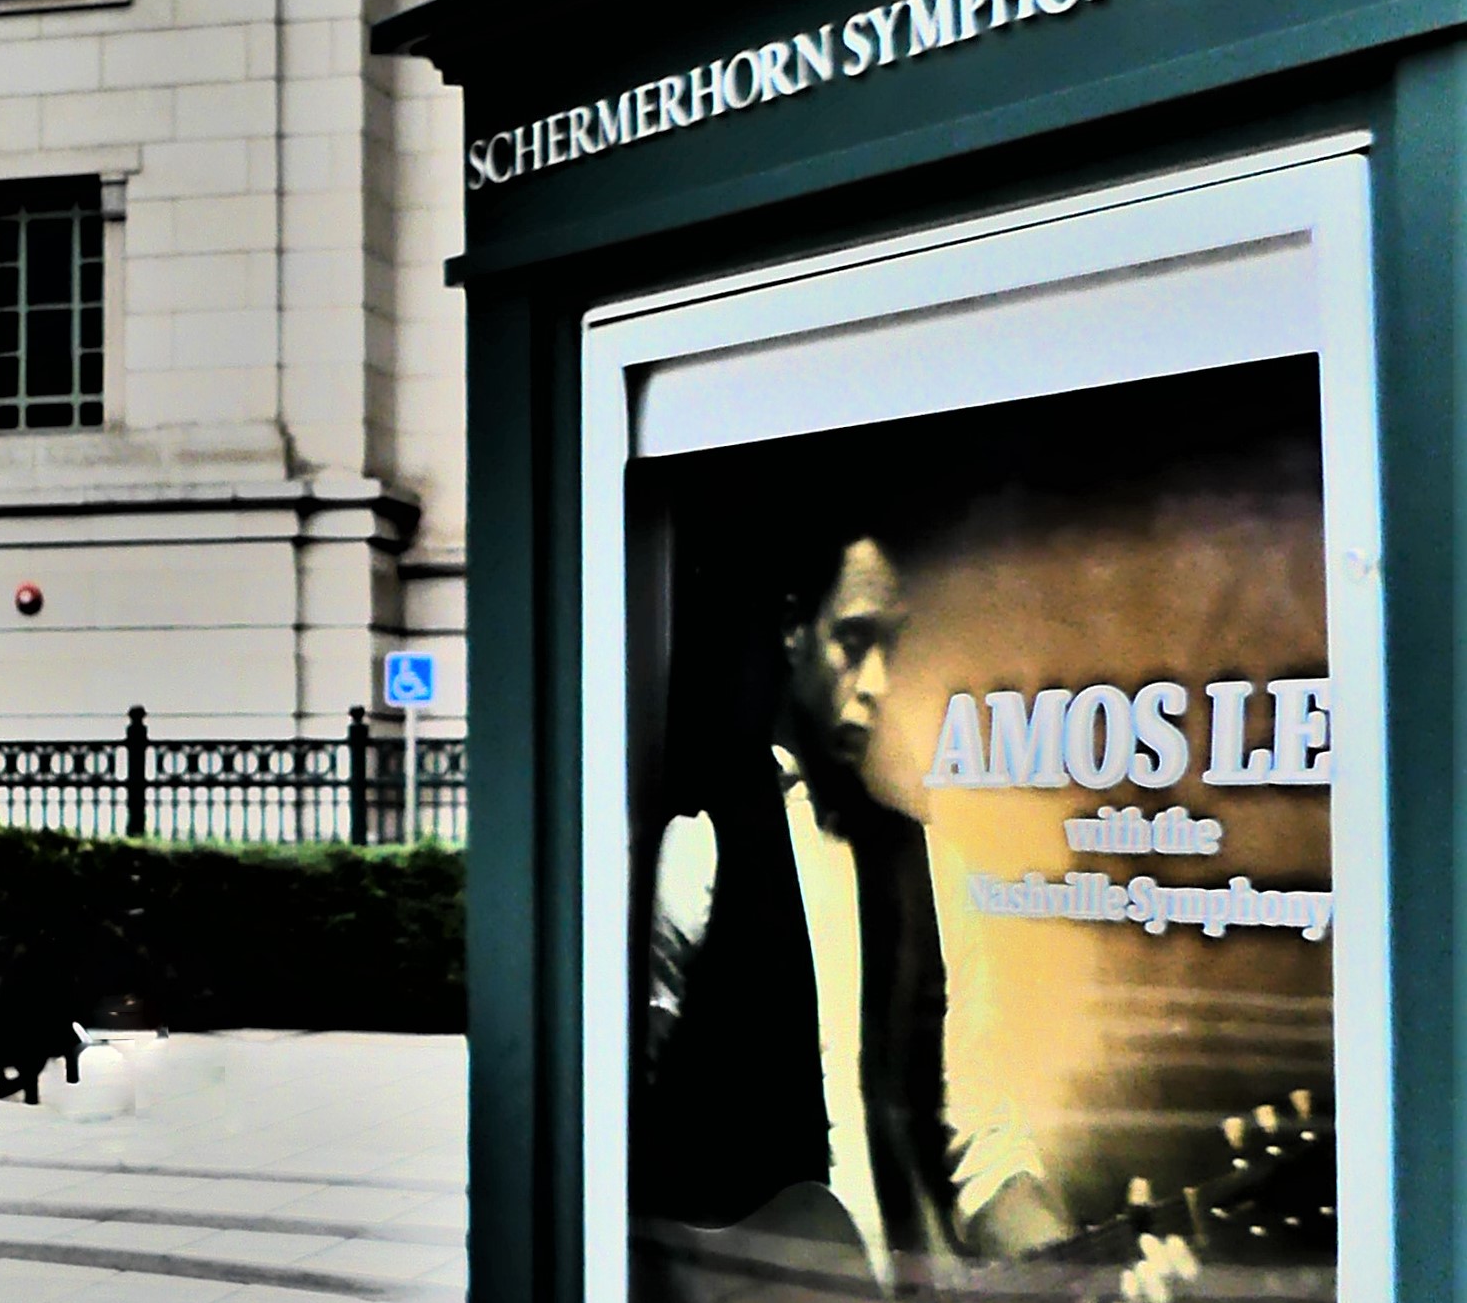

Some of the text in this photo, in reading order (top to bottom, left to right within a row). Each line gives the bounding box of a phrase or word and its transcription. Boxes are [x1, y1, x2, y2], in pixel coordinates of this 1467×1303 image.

[467, 21, 834, 191] SCHERMERHORN
[923, 681, 1190, 790] AMOS
[1063, 805, 1223, 856] with the
[967, 871, 1331, 942] Nashville Symphony
